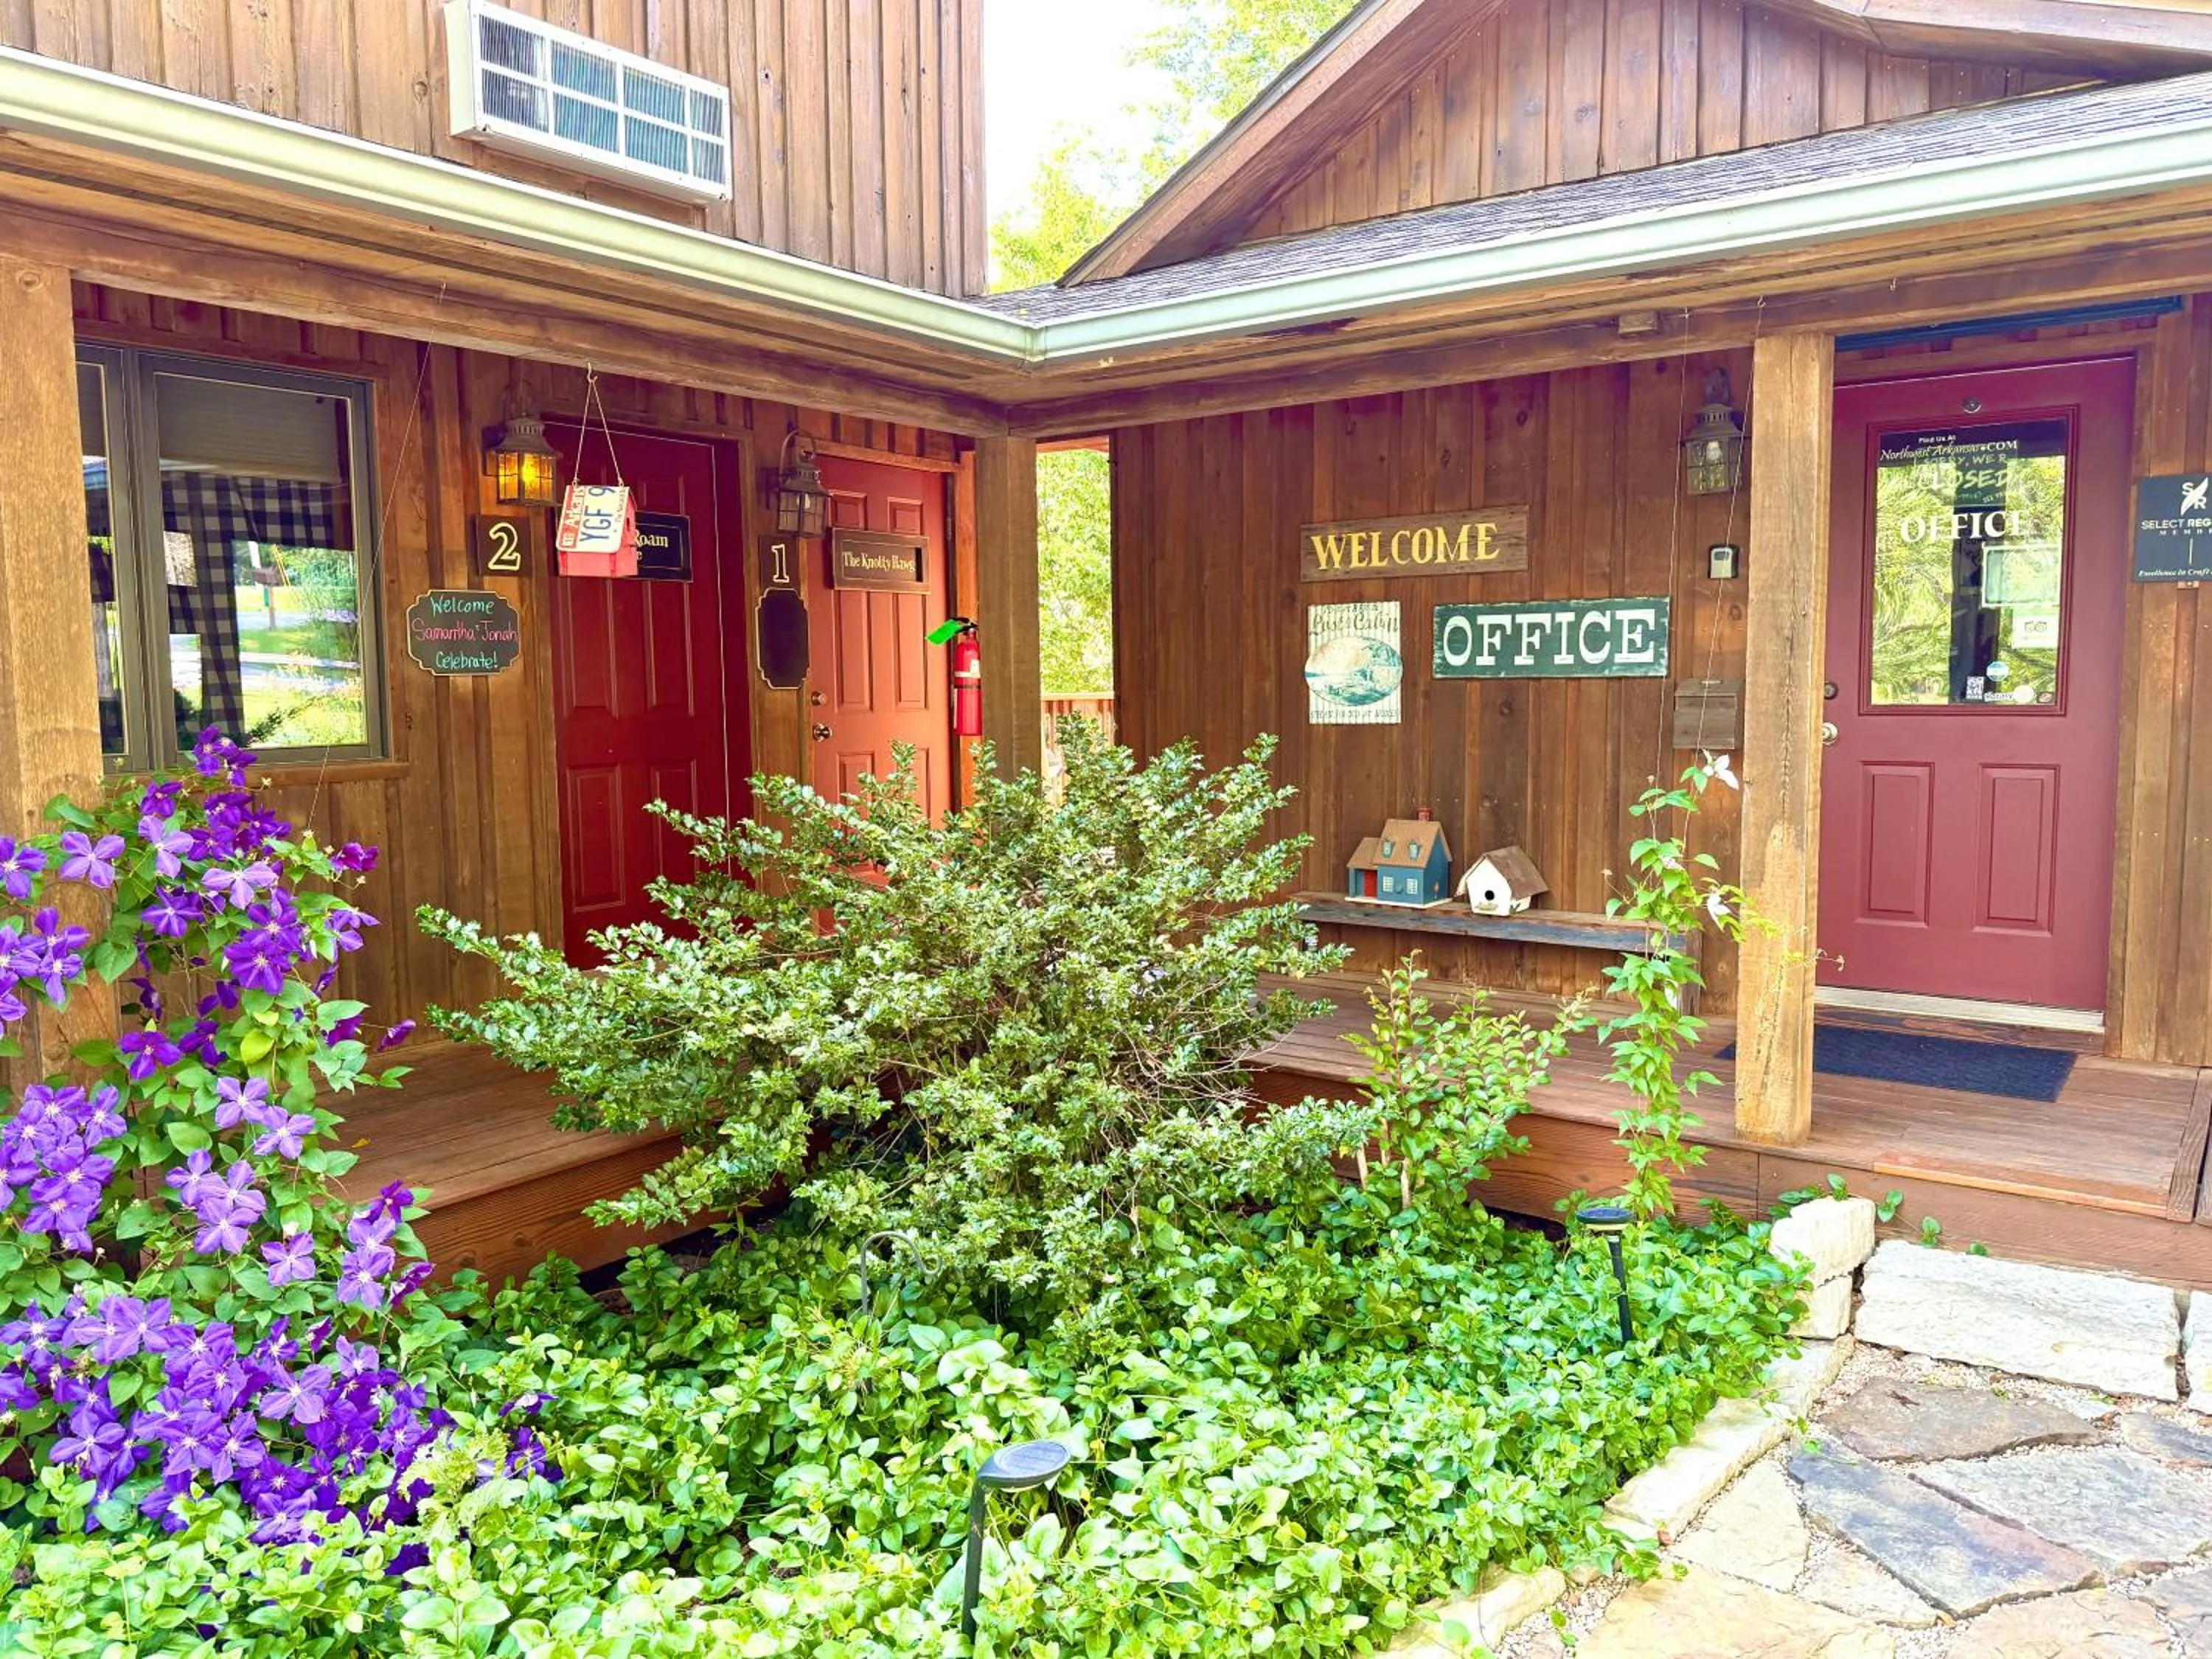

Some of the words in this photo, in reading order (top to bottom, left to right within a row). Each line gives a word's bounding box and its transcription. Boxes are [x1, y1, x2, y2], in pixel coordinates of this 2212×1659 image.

[579, 505, 613, 542] YGF
[1900, 510, 2029, 543] OFFICE
[2141, 518, 2185, 529] SELECT
[488, 522, 521, 571] 2
[771, 543, 790, 582] 1
[842, 552, 860, 567] The
[861, 552, 891, 571] Knotty
[1310, 523, 1499, 570] WELCOME
[430, 594, 495, 617] Welcome
[1442, 608, 1656, 666] OFFICE
[435, 650, 498, 669] Celebrate!
